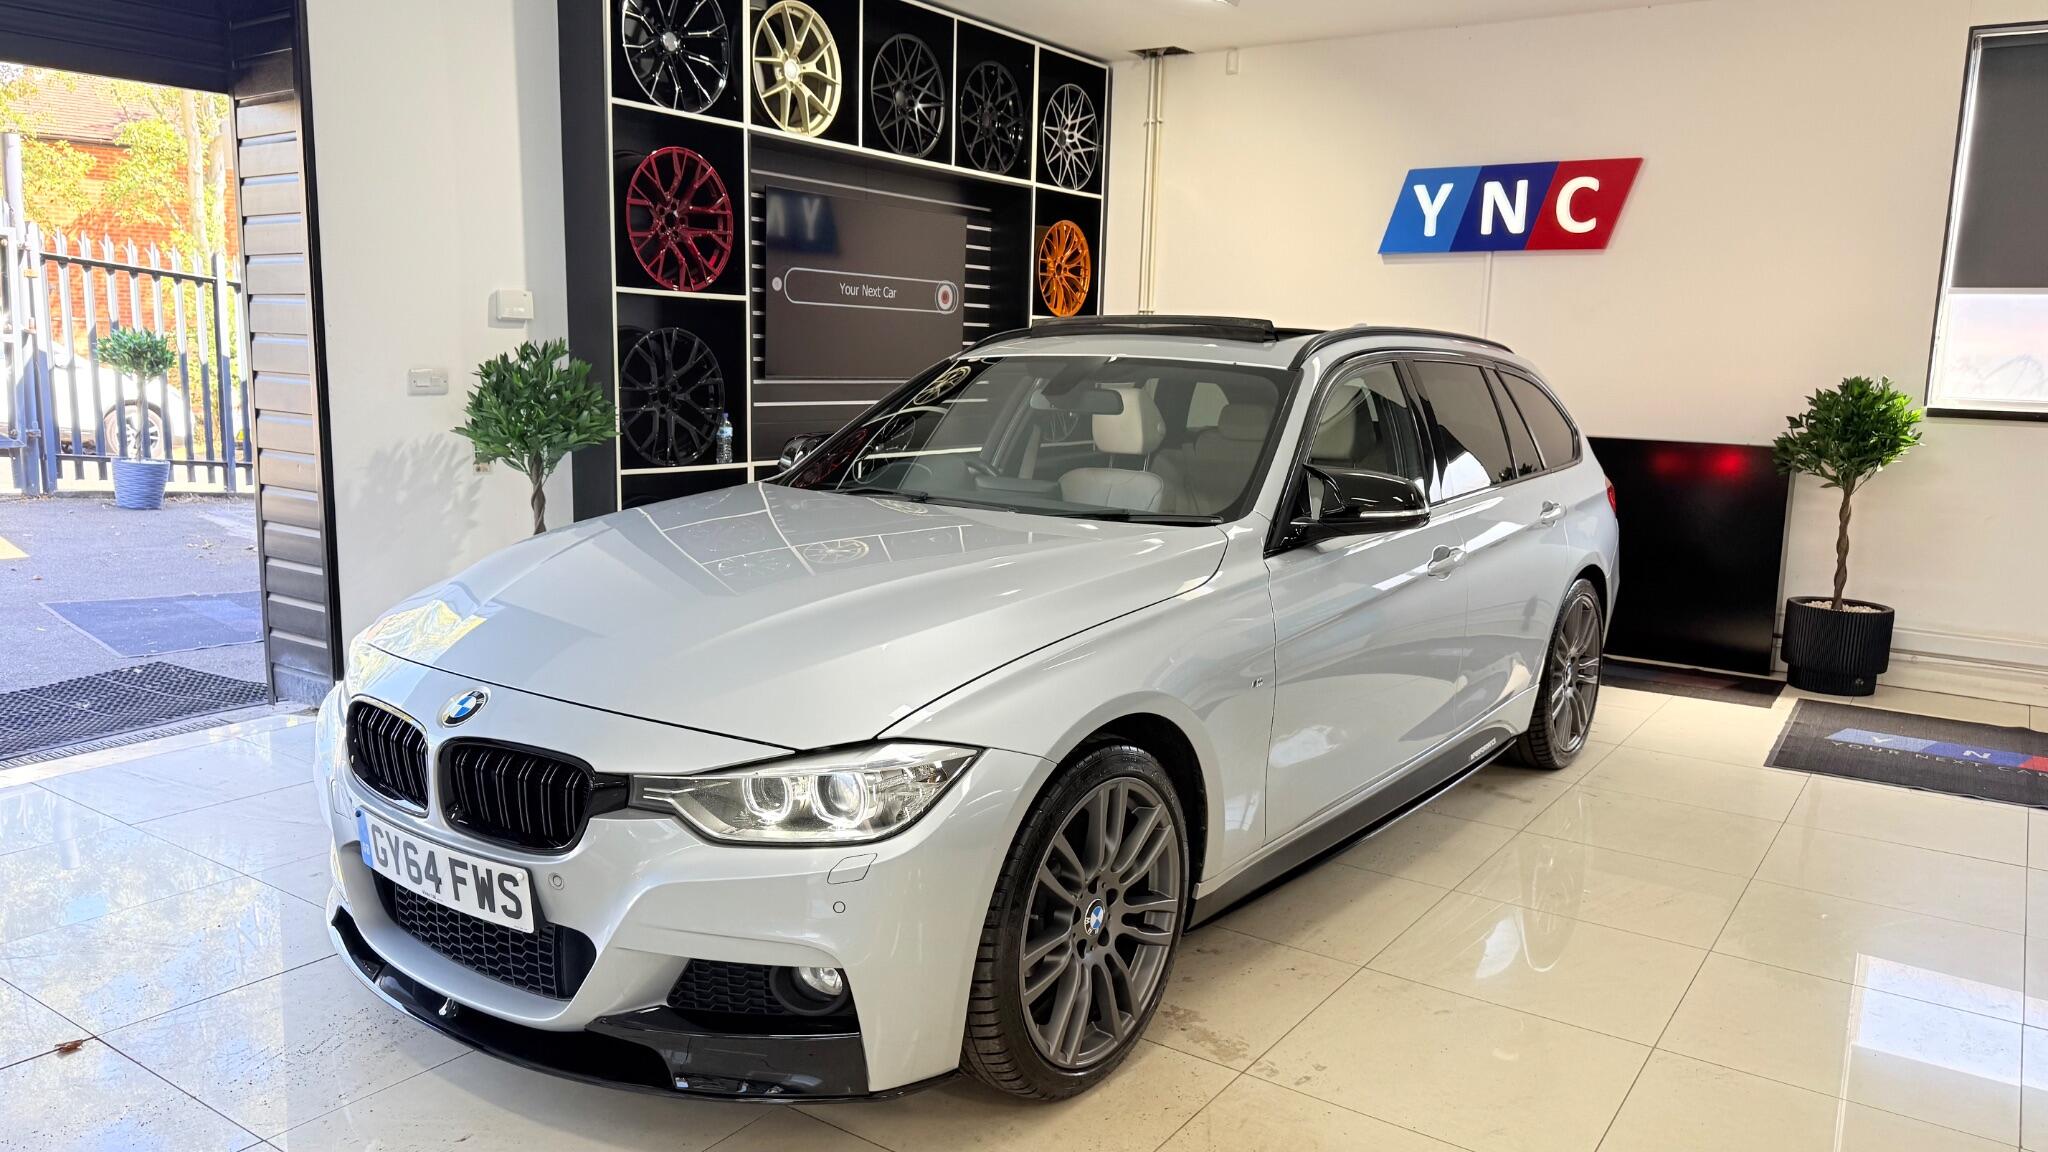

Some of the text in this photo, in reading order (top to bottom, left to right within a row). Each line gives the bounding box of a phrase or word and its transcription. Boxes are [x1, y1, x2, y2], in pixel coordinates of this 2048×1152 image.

[1413, 176, 1600, 237] YNC
[839, 282, 897, 299] Your Next Car
[1831, 741, 1900, 756] YOUR
[1915, 754, 1983, 768] NEXT
[371, 824, 523, 920] GY64 FWS
